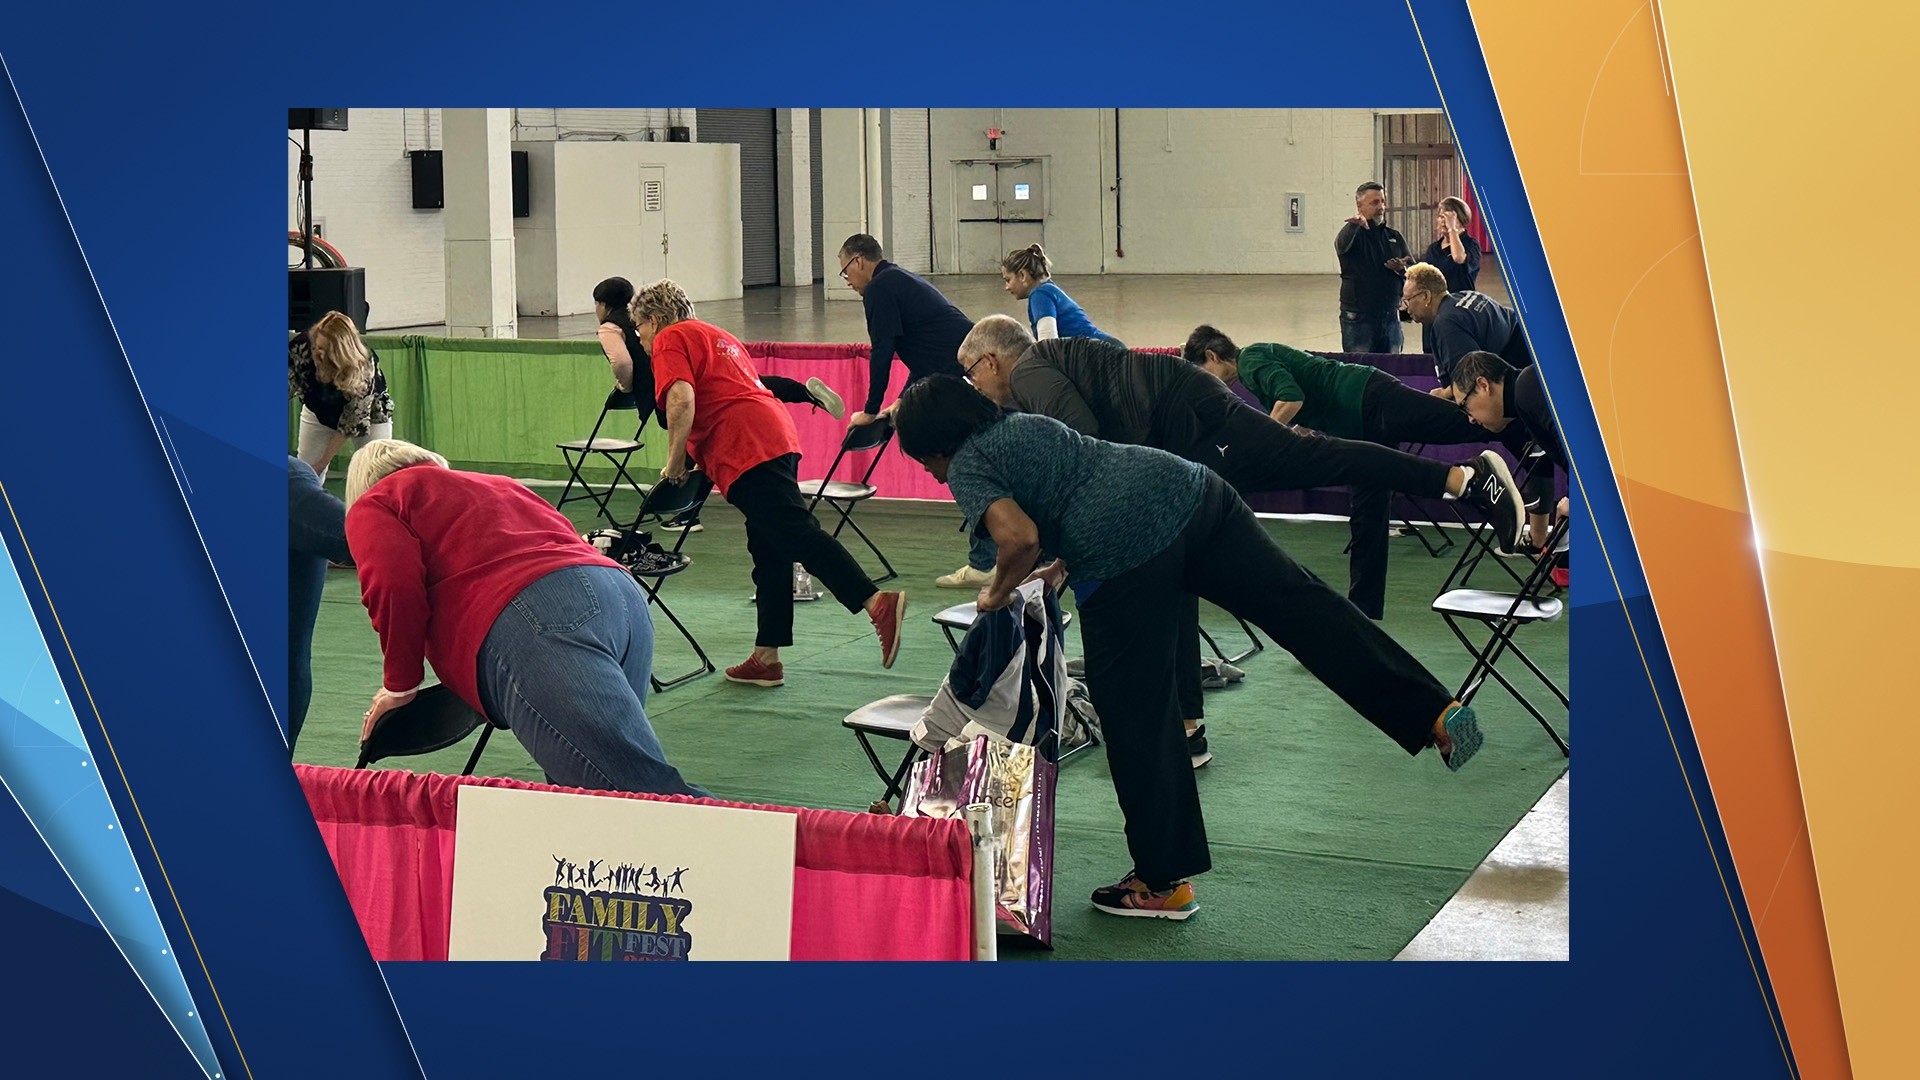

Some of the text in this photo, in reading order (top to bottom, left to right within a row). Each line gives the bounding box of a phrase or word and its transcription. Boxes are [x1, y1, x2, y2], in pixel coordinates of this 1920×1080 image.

[547, 891, 686, 936] FAMILY
[548, 923, 686, 961] FIT FEST
